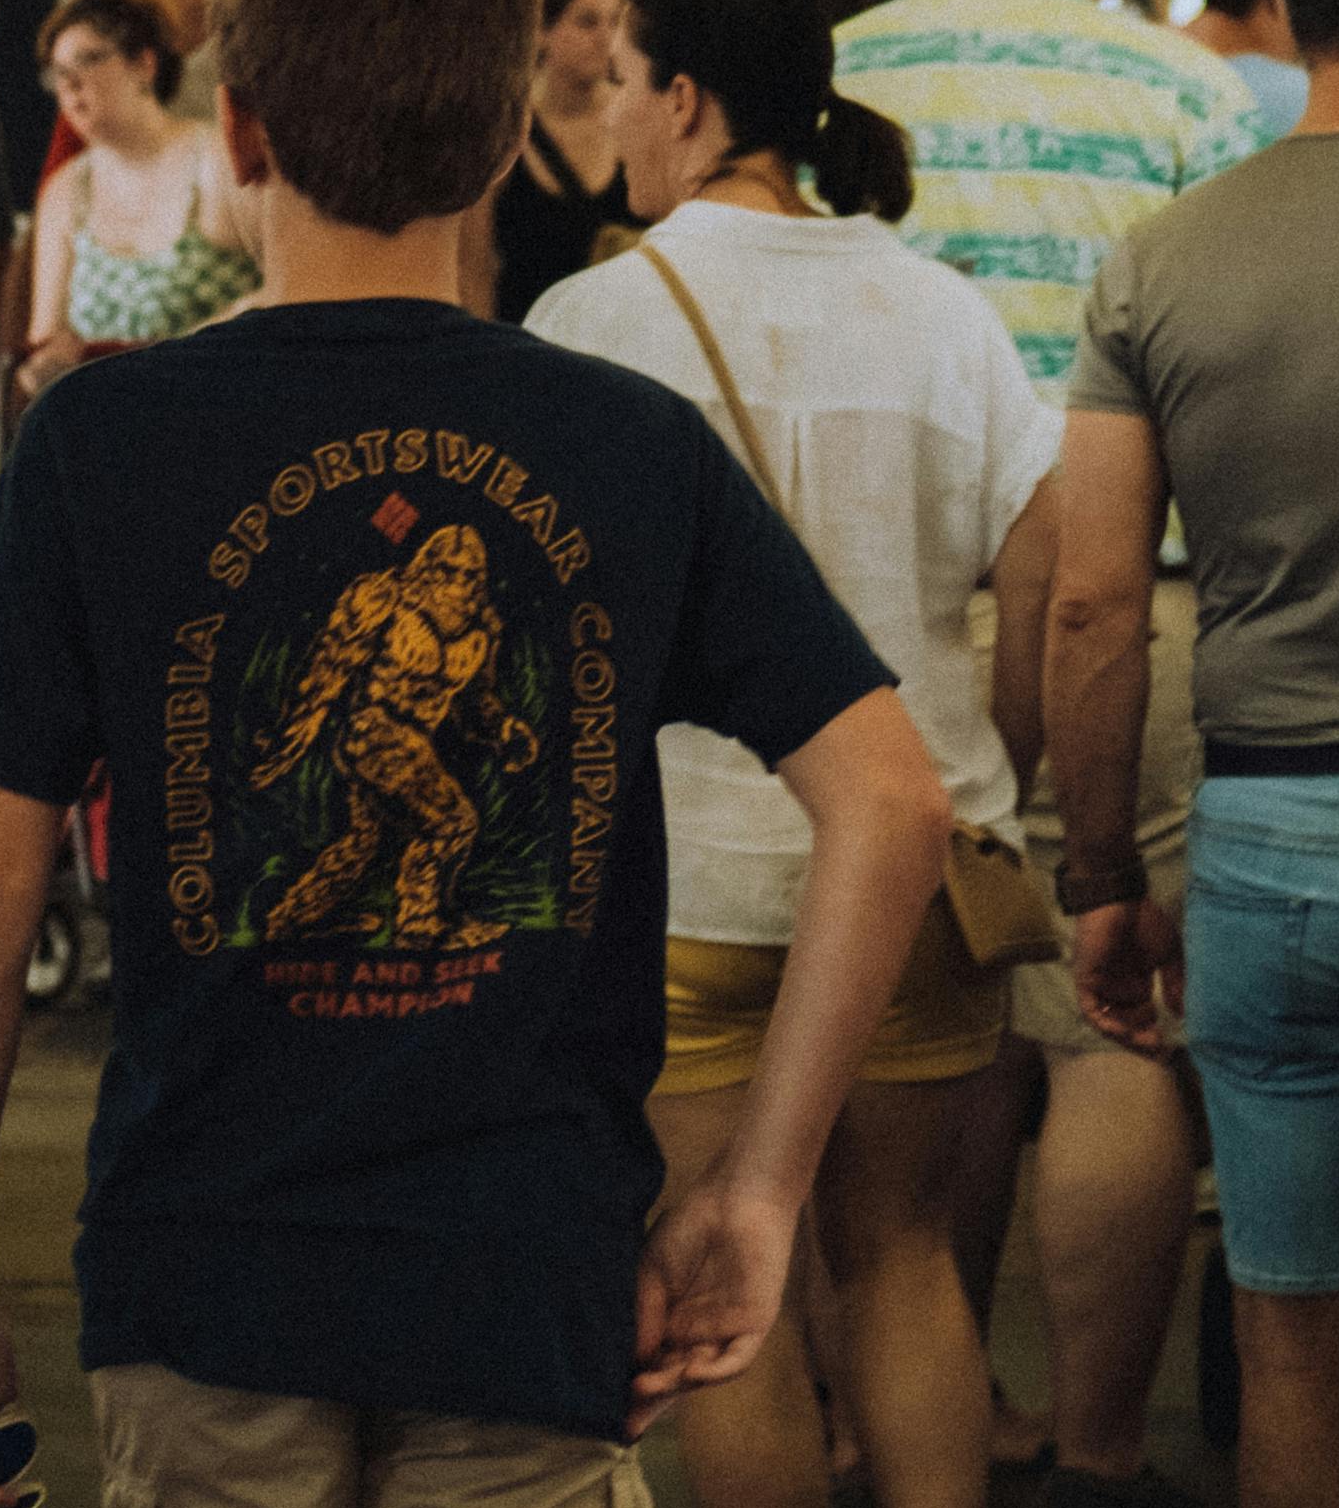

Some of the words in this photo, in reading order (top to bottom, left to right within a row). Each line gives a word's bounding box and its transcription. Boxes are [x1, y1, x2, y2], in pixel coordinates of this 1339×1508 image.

[165, 613, 226, 955] COLUMBIA
[209, 427, 592, 589] SPORTSWEAR
[565, 602, 617, 936] COMPANY
[353, 962, 421, 983] AND
[434, 951, 502, 982] SEEK
[288, 983, 474, 1017] CHAMPION
